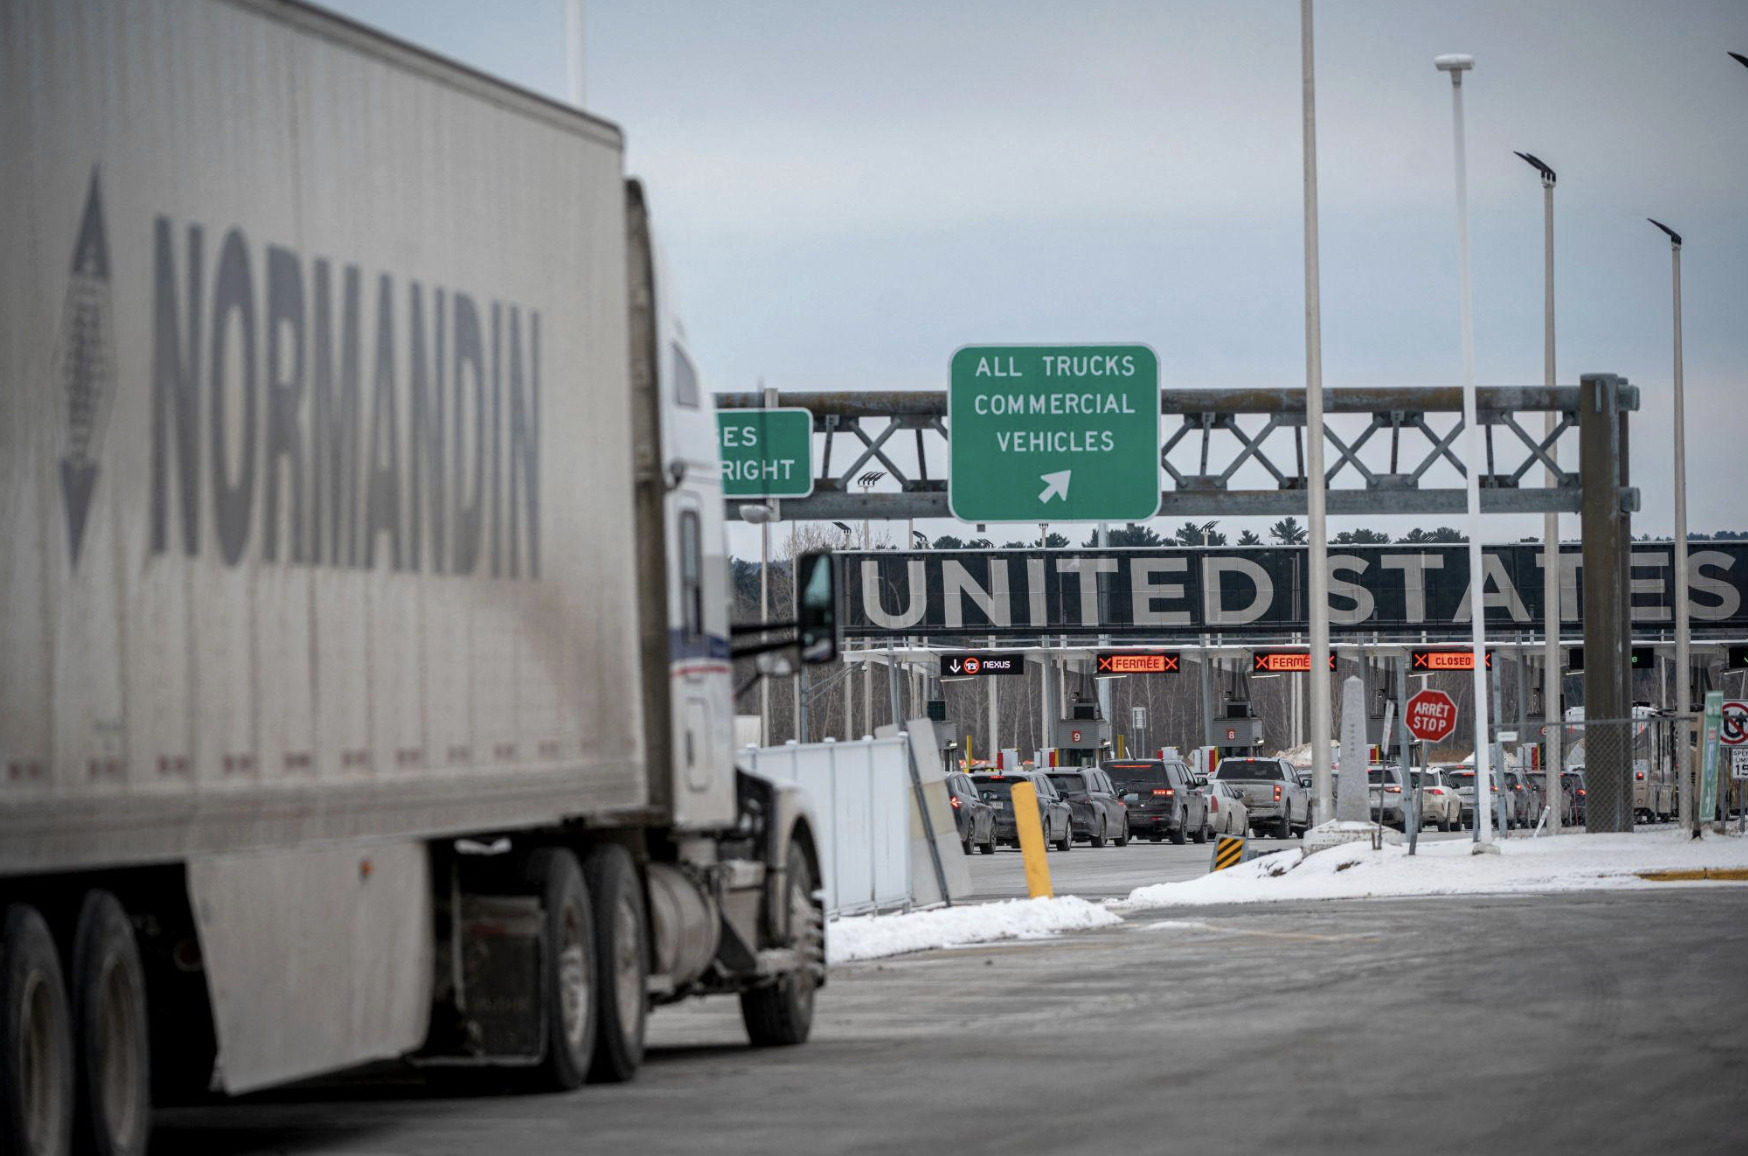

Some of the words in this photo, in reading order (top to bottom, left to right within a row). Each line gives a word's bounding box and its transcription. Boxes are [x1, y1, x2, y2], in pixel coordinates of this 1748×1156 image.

[975, 356, 1023, 377] ALL
[1042, 355, 1136, 376] TRUCKS
[152, 215, 541, 582] NORMANDIN
[974, 393, 1136, 415] COMMERCIAL
[716, 426, 758, 447] ES
[996, 430, 1115, 452] VEHICLES
[721, 459, 795, 480] RIGHT
[861, 557, 1274, 629] UNITED
[1325, 549, 1742, 625] STATES
[1115, 656, 1161, 669] FERMÉE
[1272, 655, 1310, 668] FERMÉ
[1435, 657, 1471, 666] CLOSED
[1413, 716, 1447, 732] STOP
